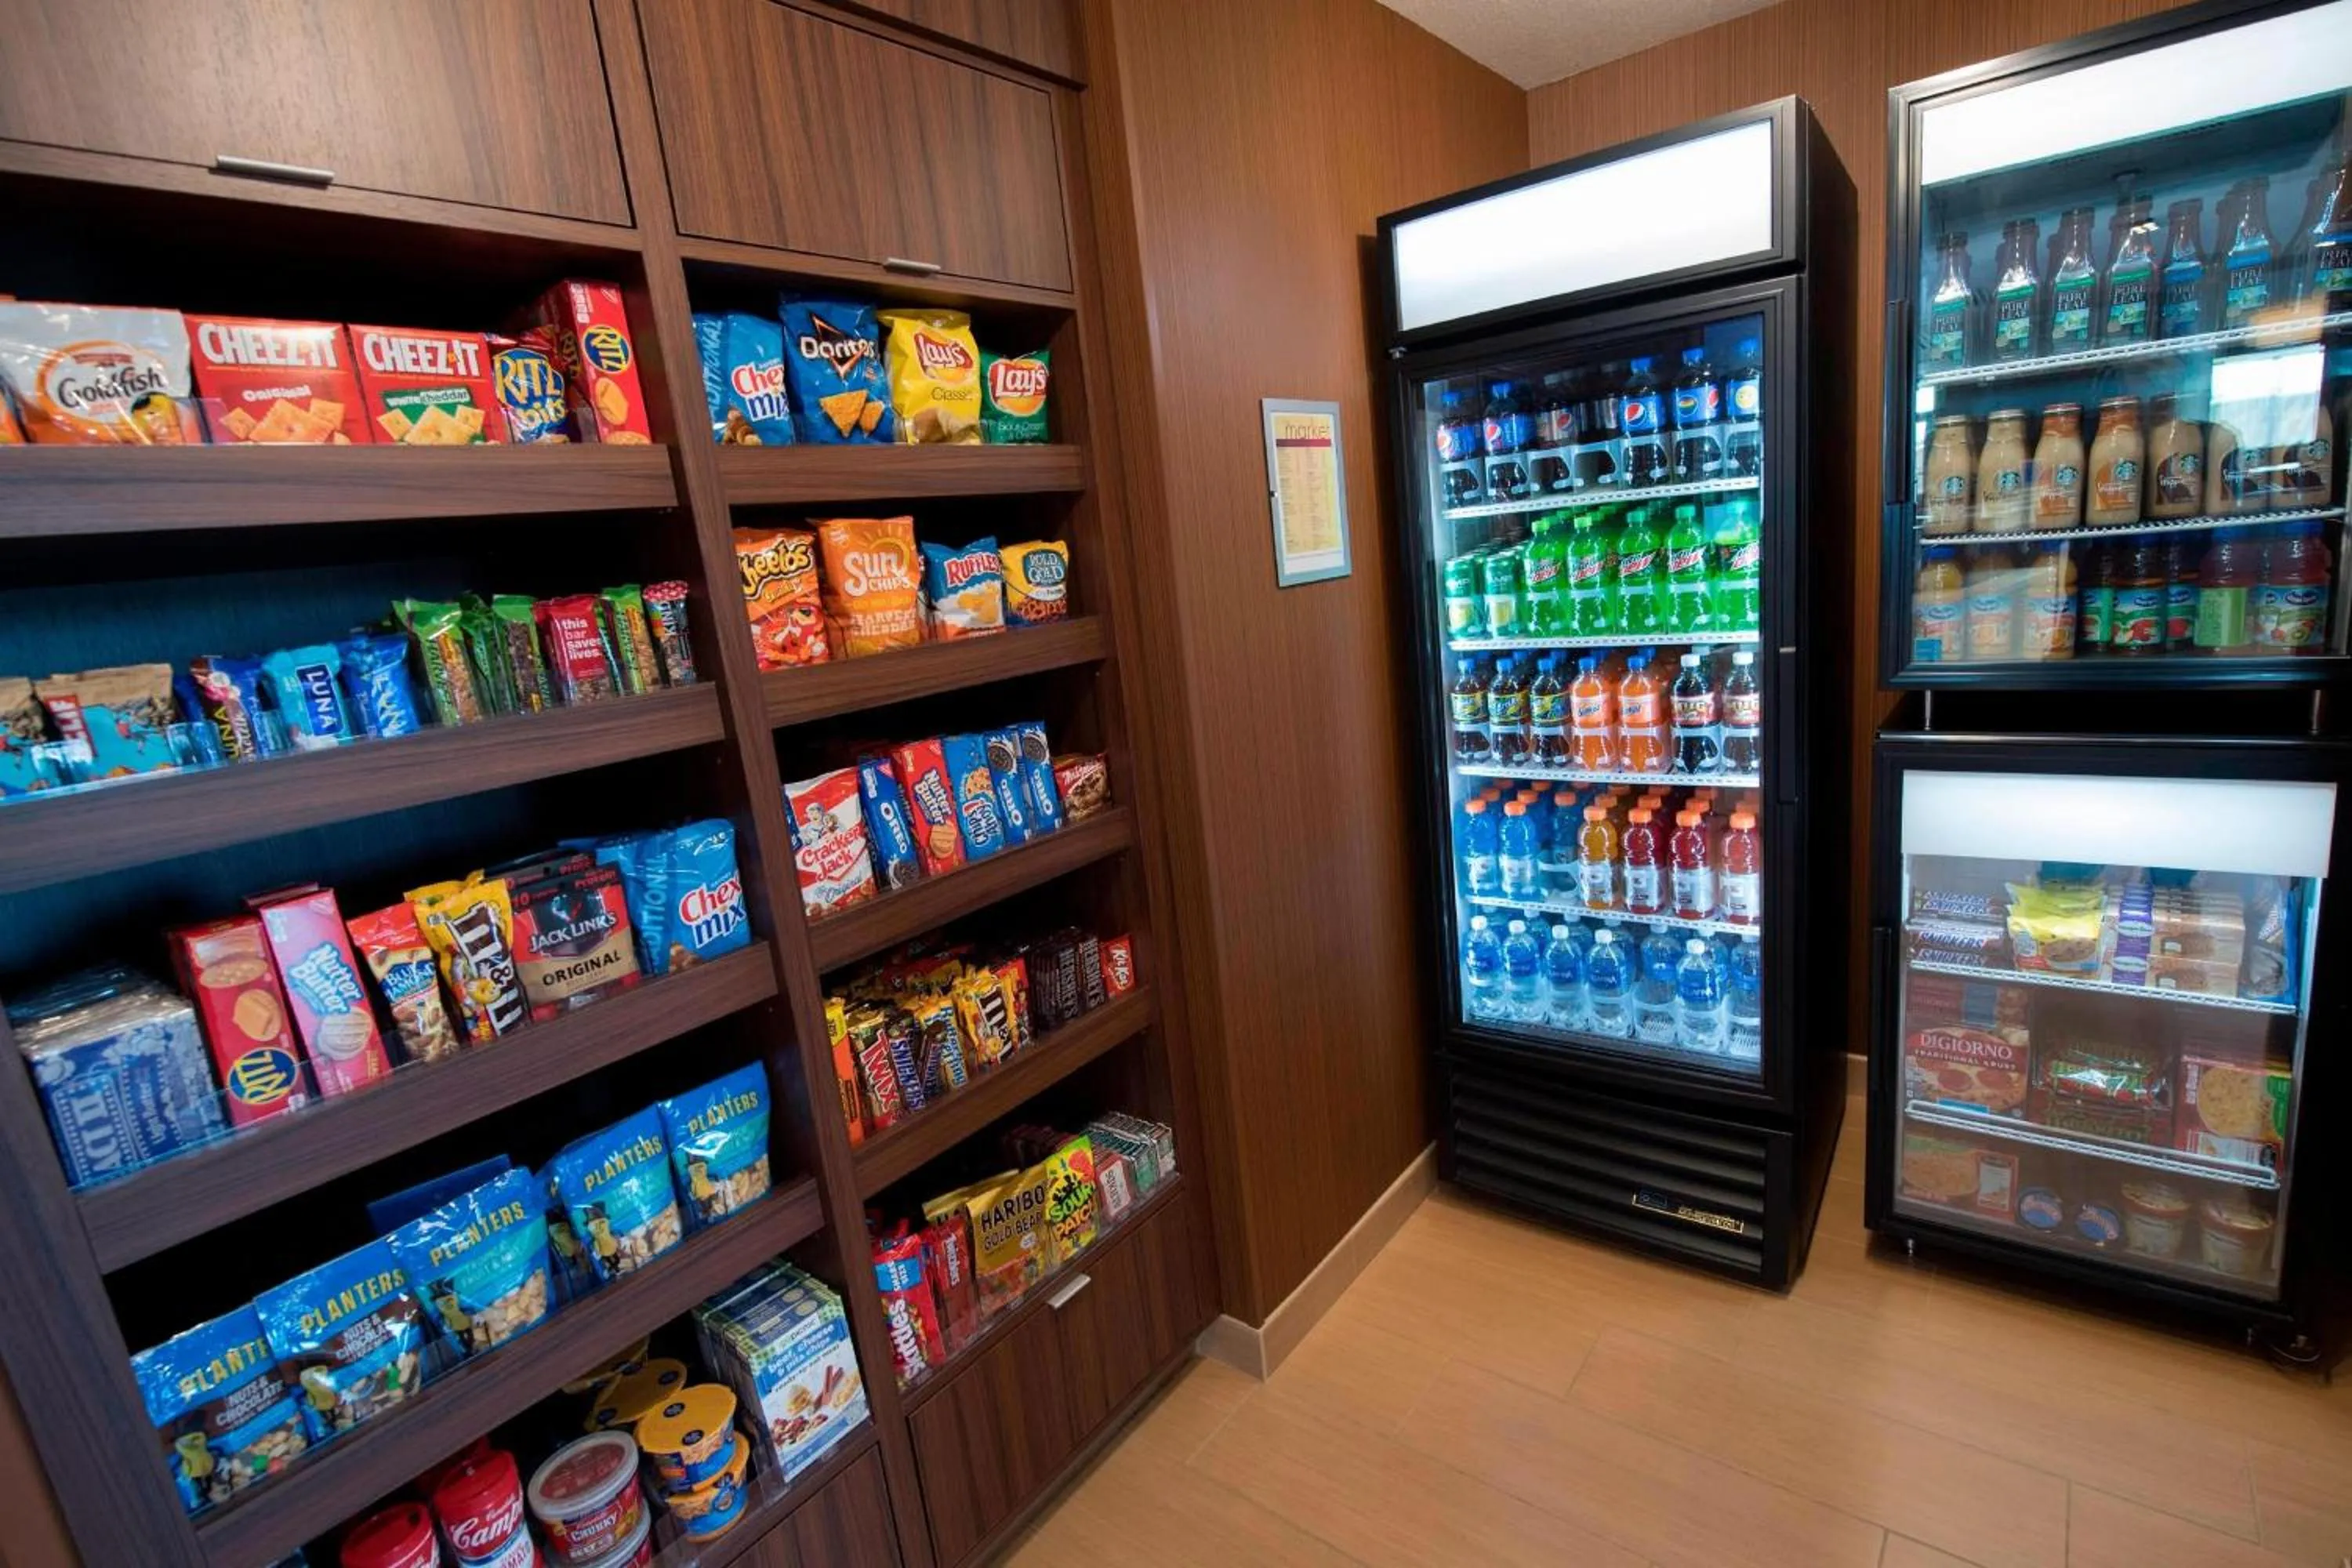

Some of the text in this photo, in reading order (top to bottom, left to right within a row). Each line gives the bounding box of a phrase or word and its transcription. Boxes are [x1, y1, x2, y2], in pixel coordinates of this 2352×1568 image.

[595, 325, 629, 372] RITZ
[800, 335, 875, 361] Doritos
[918, 332, 972, 367] Lay's
[59, 366, 166, 408] Goldfish
[495, 354, 564, 406] RITZ
[995, 363, 1047, 397] Lay's
[845, 549, 906, 597] Sun
[307, 669, 336, 729] LUNA
[802, 826, 862, 867] Cracker
[880, 801, 907, 854] OREO
[816, 849, 854, 882] Jack
[681, 877, 742, 924] Chex
[528, 928, 572, 953] JACK
[290, 964, 353, 1016] Butter
[314, 946, 364, 1004] Nutter
[543, 949, 621, 985] ORIGINAL
[1919, 1033, 2013, 1059] DIGIORNO
[234, 1050, 292, 1103] RITZ
[891, 1039, 926, 1111] SNICKERS
[585, 1134, 663, 1192] PLANTERS
[981, 1185, 1045, 1233] HARIBO
[1050, 1185, 1094, 1223] SOUR
[430, 1200, 524, 1267] PLANTERS
[299, 1268, 406, 1338] PLANTERS
[889, 1298, 927, 1380] Skittles
[179, 1337, 269, 1402] PLANTE
